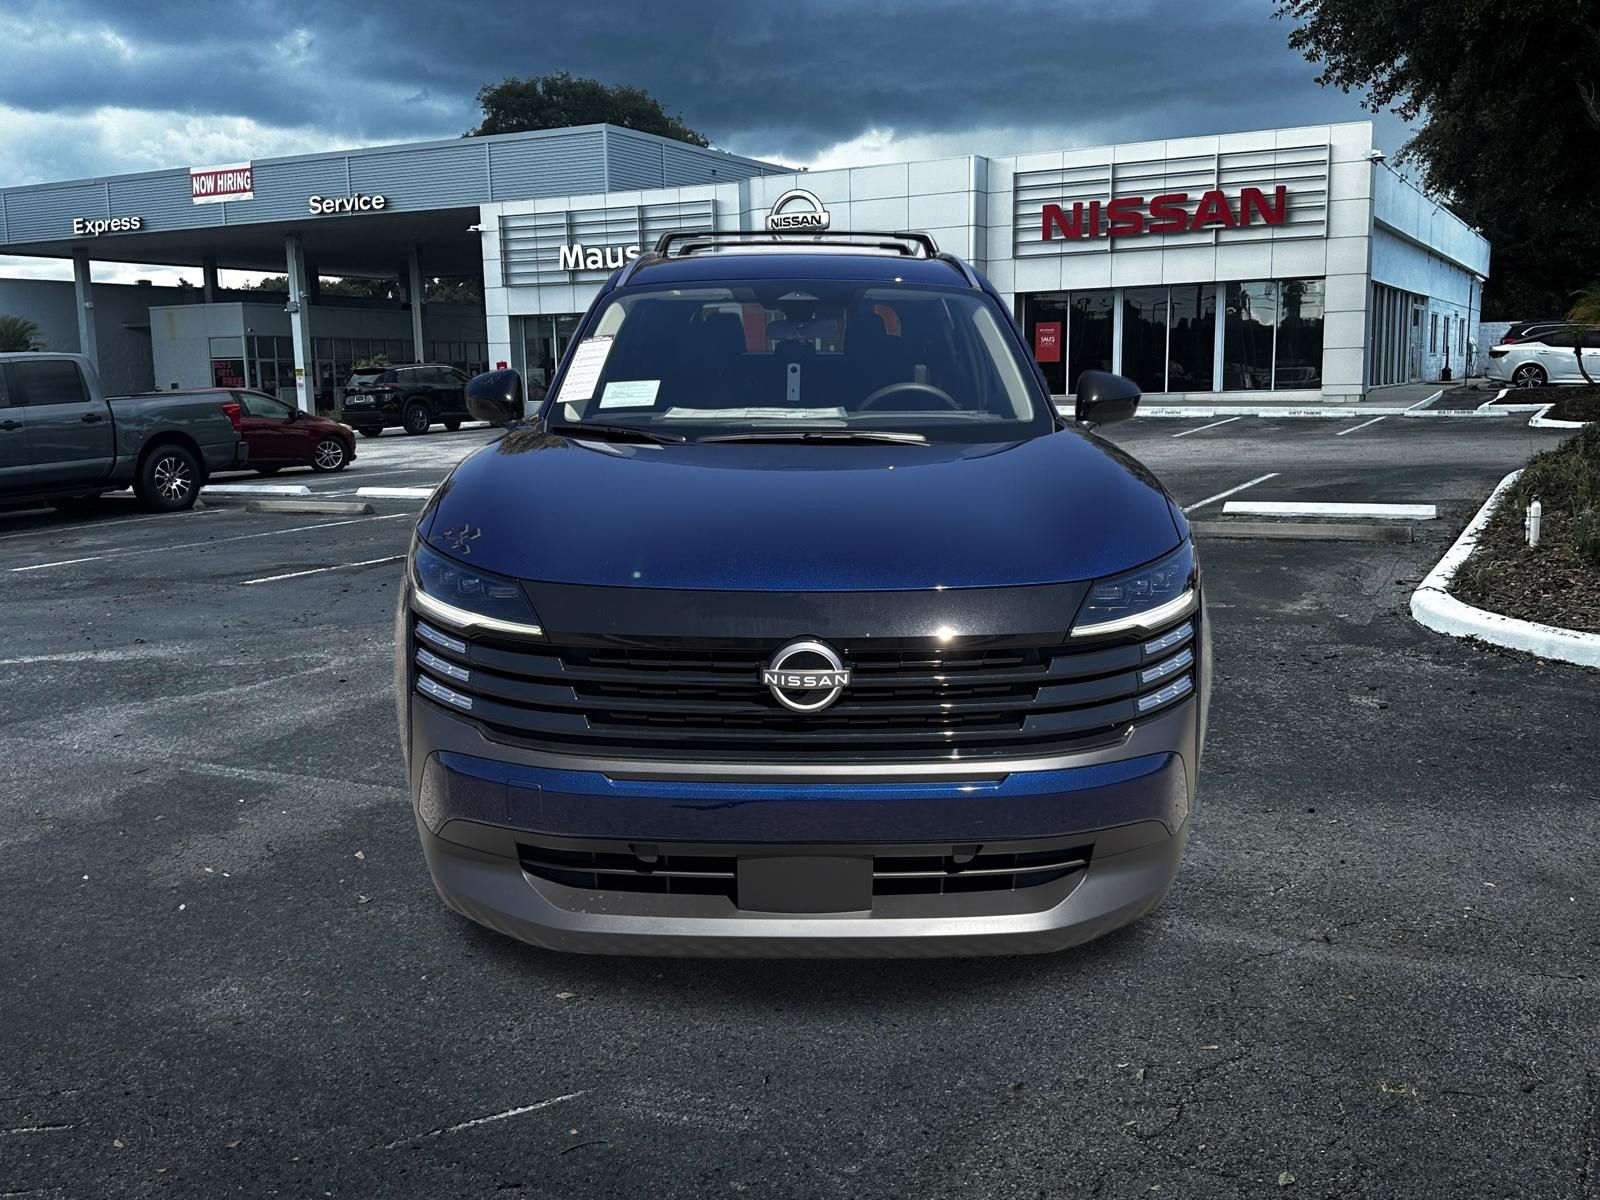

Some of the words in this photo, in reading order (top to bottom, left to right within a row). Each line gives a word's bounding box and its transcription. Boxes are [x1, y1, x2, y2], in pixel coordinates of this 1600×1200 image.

[192, 174, 215, 195] NOW
[217, 171, 251, 192] HIRING
[309, 193, 385, 214] Service
[1042, 185, 1287, 241] NISSAN
[73, 216, 141, 236] Express
[770, 214, 822, 228] NISSAN
[559, 243, 640, 271] Maus
[223, 376, 244, 386] FREE
[764, 673, 848, 687] NISSAN
